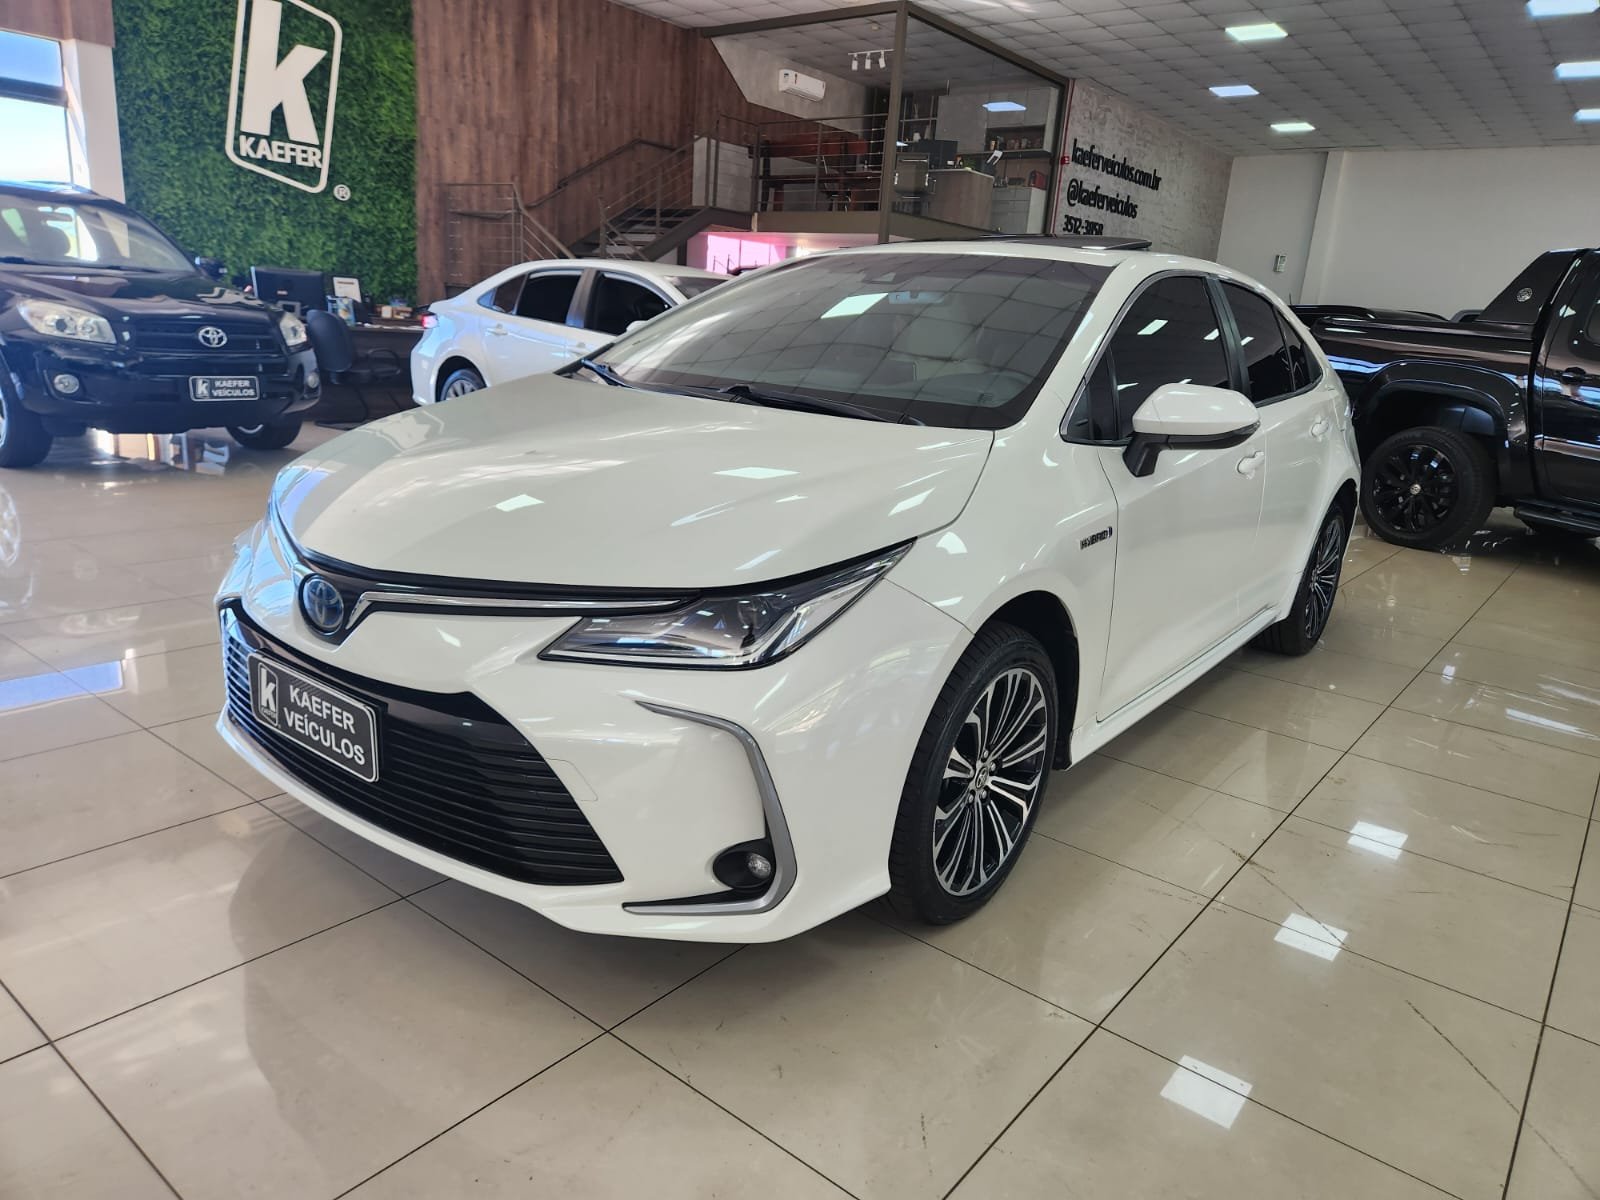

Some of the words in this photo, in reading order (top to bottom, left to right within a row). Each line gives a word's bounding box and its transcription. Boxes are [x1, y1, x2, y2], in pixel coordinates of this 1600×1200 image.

[239, 135, 323, 169] KAEFER
[1072, 138, 1162, 191] kaeferveiculos.com.br
[1067, 178, 1138, 219] @kaeferveiculos
[214, 380, 250, 388] KAEFER
[1080, 530, 1108, 549] HYBRID
[290, 684, 356, 734] KAEFER
[283, 707, 365, 765] VEÍCULOS
